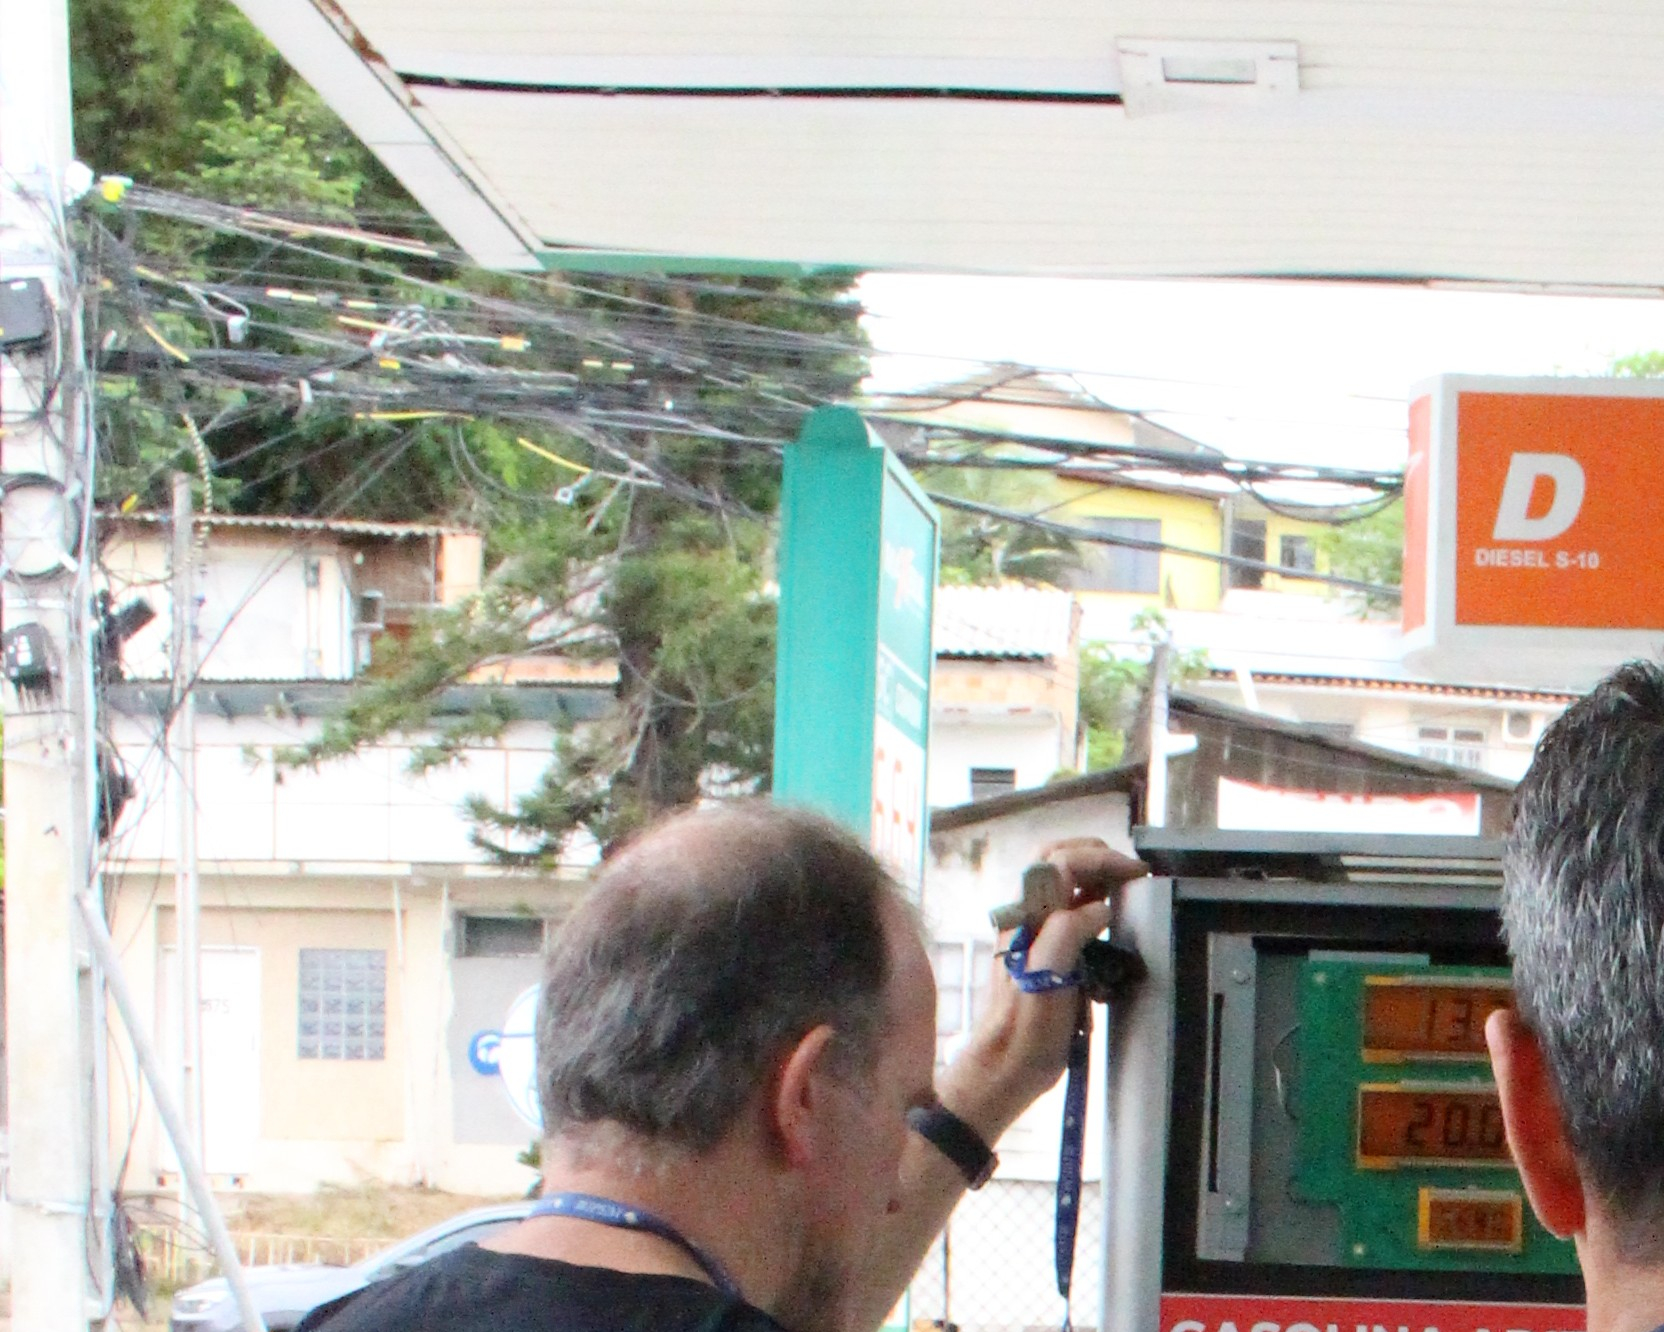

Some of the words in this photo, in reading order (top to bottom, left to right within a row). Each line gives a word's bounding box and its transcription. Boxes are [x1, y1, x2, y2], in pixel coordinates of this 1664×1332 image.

[1492, 452, 1587, 542] D
[1475, 547, 1549, 568] DIESEL
[1555, 550, 1600, 570] S-10
